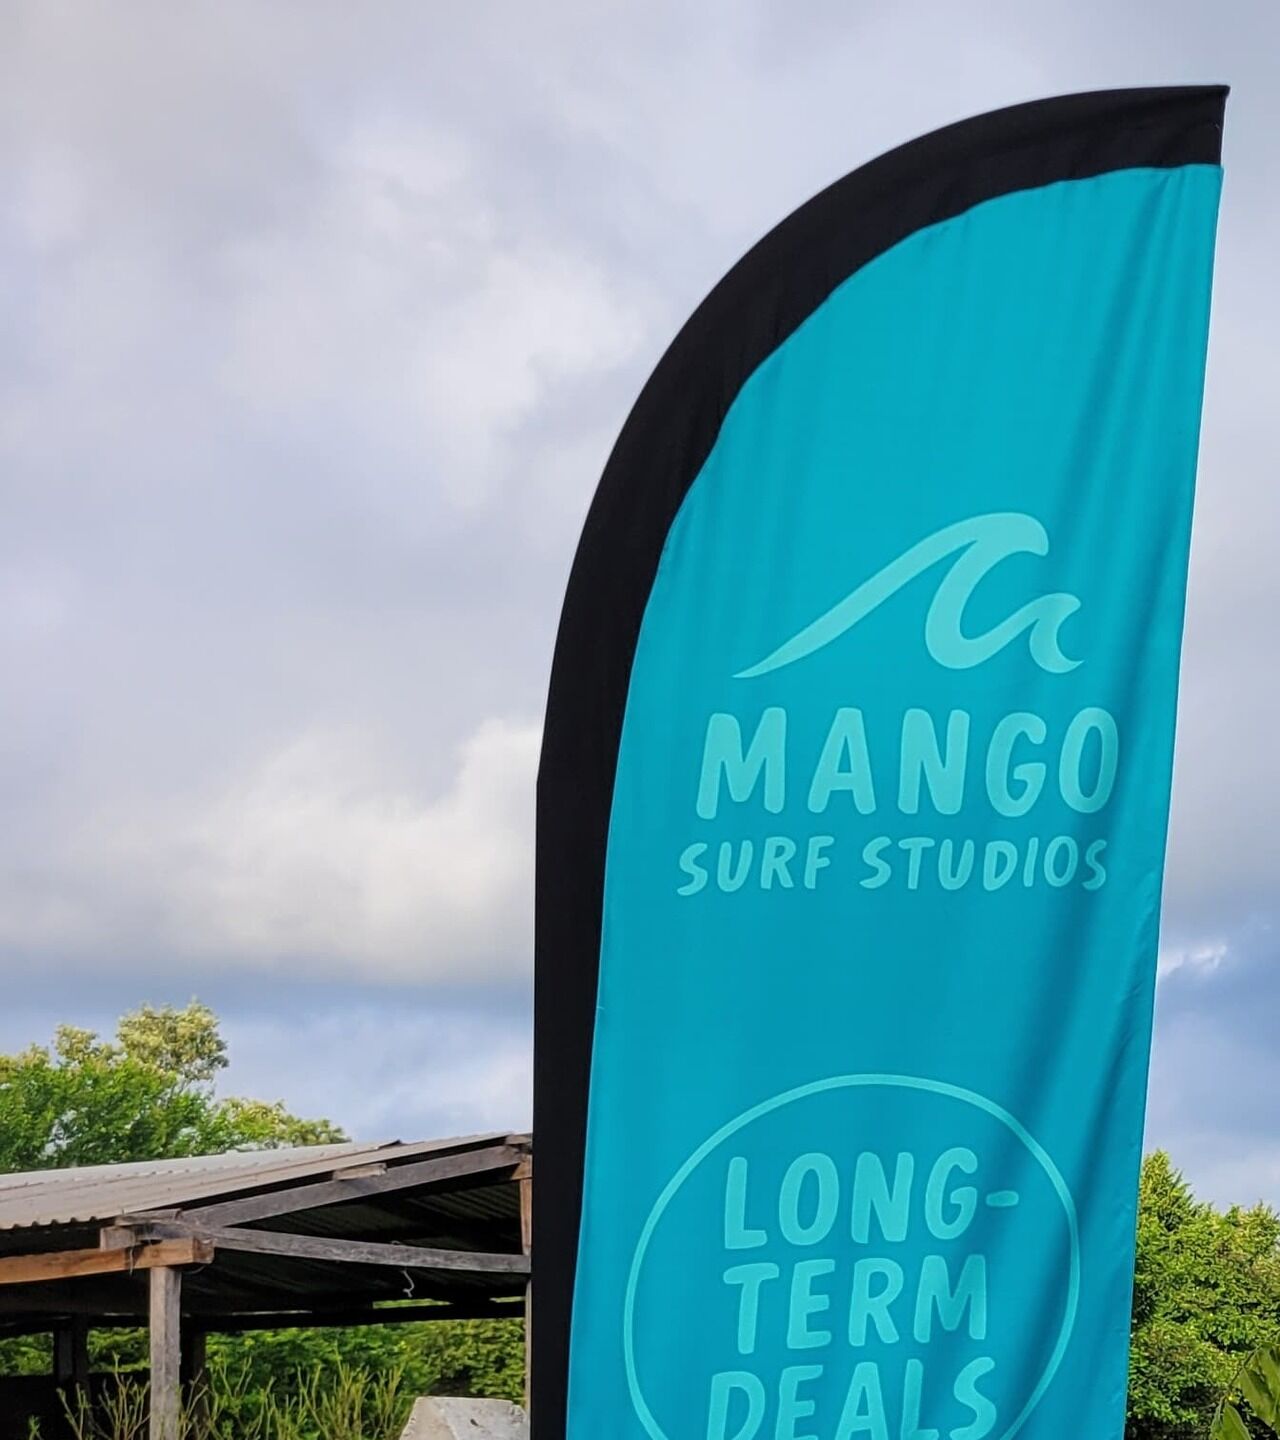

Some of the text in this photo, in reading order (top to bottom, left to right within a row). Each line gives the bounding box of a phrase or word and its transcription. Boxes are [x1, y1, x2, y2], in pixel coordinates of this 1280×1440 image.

[696, 706, 1120, 820] MANGO
[676, 835, 1109, 897] SURF STUDIOS
[723, 1146, 1019, 1250] LONG-
[723, 1254, 987, 1355] TERM
